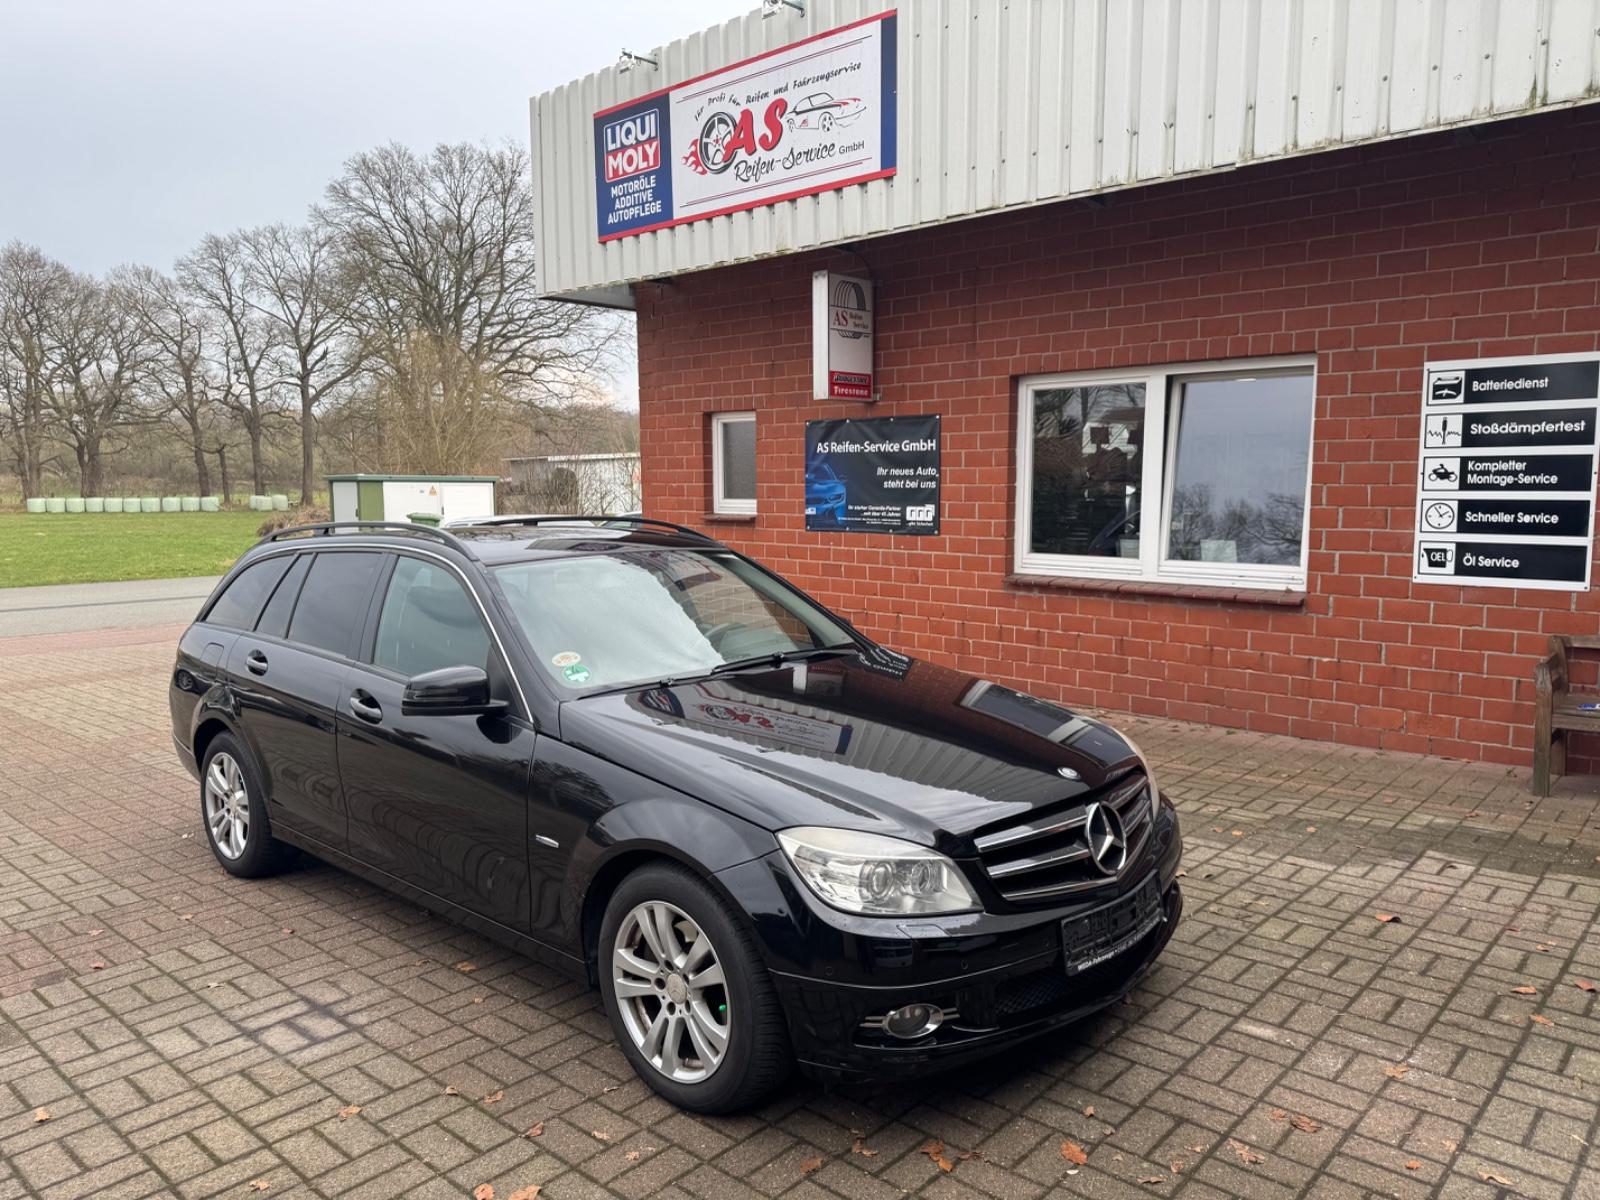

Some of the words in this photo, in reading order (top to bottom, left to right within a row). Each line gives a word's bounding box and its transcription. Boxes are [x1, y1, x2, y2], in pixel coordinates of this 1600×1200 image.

[745, 91, 770, 104] Reifen
[773, 83, 789, 96] und
[793, 62, 862, 89] Fahrzeugservice
[607, 113, 656, 151] LIQUI
[722, 97, 789, 162] AS
[608, 141, 658, 178] MOLY
[734, 142, 836, 183] Reifen-Service
[838, 140, 865, 155] GmbH
[611, 175, 656, 198] MOTORÖLE
[614, 189, 654, 210] ADDITIVE
[607, 200, 662, 225] AUTOPFLEGE
[832, 310, 849, 327] AS
[1472, 377, 1549, 392] Batteriedienst
[1470, 420, 1586, 435] Stoßdämpfertest
[816, 442, 829, 453] AS
[831, 440, 900, 453] Reifen-Service
[901, 439, 936, 452] GmbH
[877, 467, 888, 476] Ihr
[889, 468, 914, 476] neues
[1468, 460, 1527, 473] Kompletter
[883, 480, 904, 489] steht
[905, 480, 919, 488] bei
[1467, 473, 1558, 486] Montage-Service
[1465, 511, 1514, 523] Schneller
[1517, 512, 1559, 524] Service
[1430, 551, 1446, 561] OEL
[1463, 553, 1475, 566] Öl
[1478, 556, 1519, 568] Service
